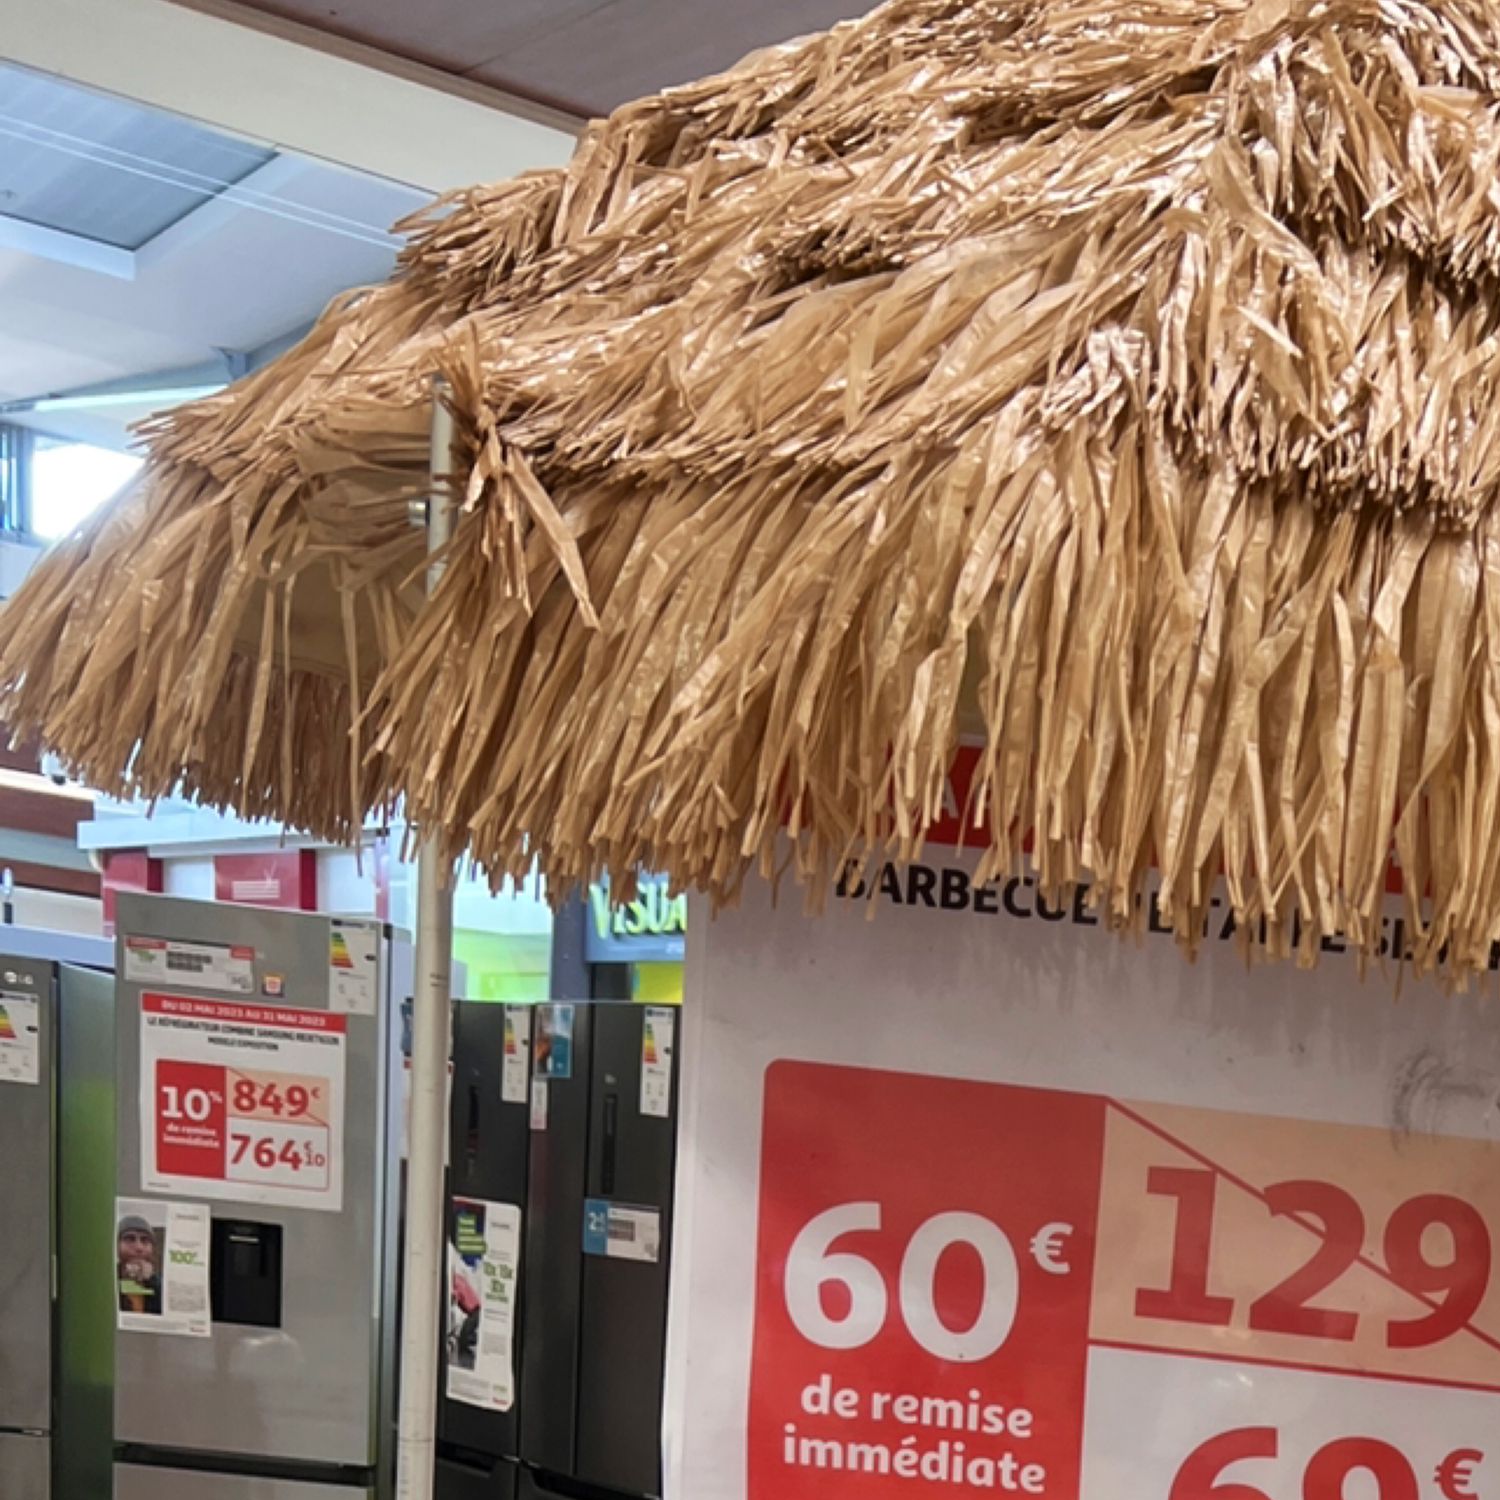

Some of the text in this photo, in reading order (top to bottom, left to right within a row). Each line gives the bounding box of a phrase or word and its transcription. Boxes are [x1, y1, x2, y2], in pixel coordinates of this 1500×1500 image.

[801, 1374, 1034, 1440] de remise
[782, 1423, 1046, 1495] immédiate
